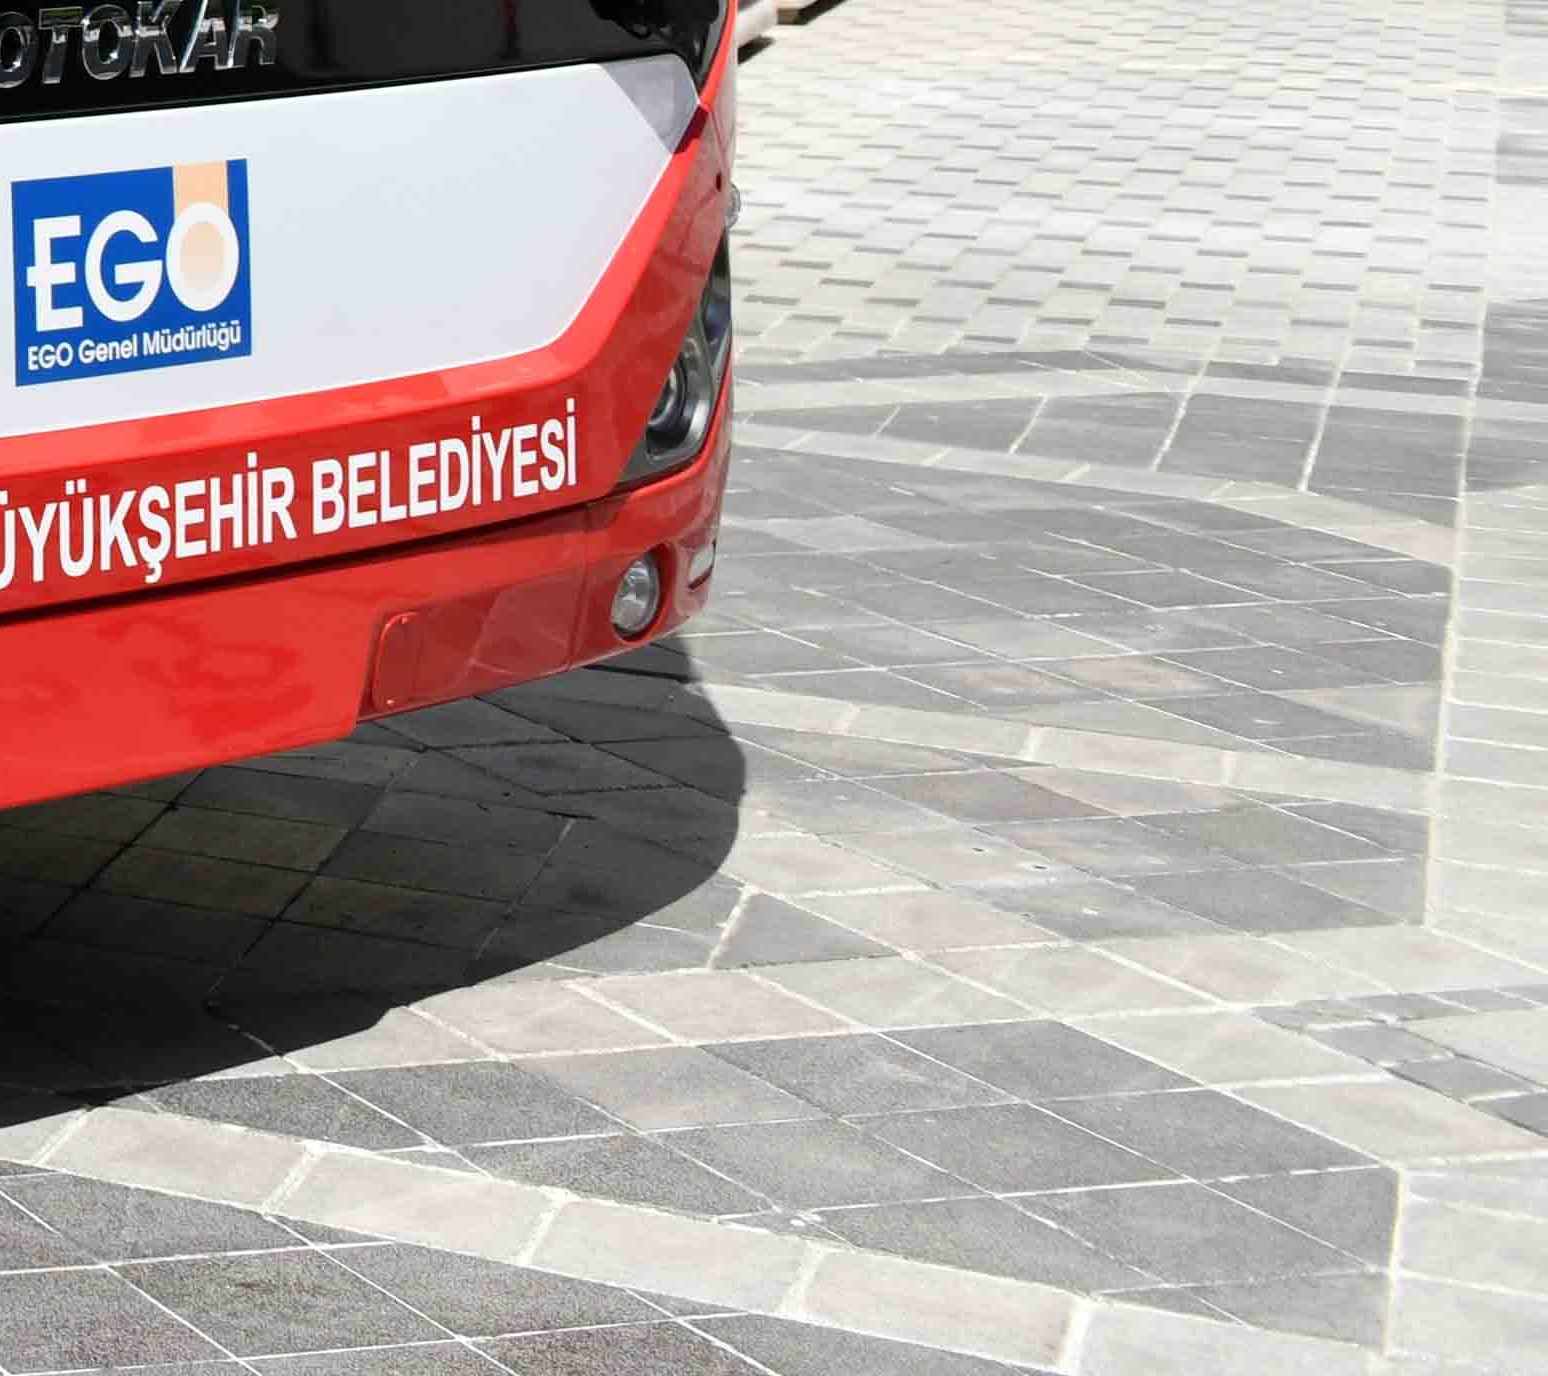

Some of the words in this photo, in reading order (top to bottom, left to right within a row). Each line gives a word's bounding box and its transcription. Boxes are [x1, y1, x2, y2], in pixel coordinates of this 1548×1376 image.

[27, 202, 239, 332] EGO
[27, 342, 73, 371] EGO
[78, 333, 139, 364] Genel
[142, 320, 242, 356] Müdürlüğü
[312, 396, 578, 532] BELEDİYESİ
